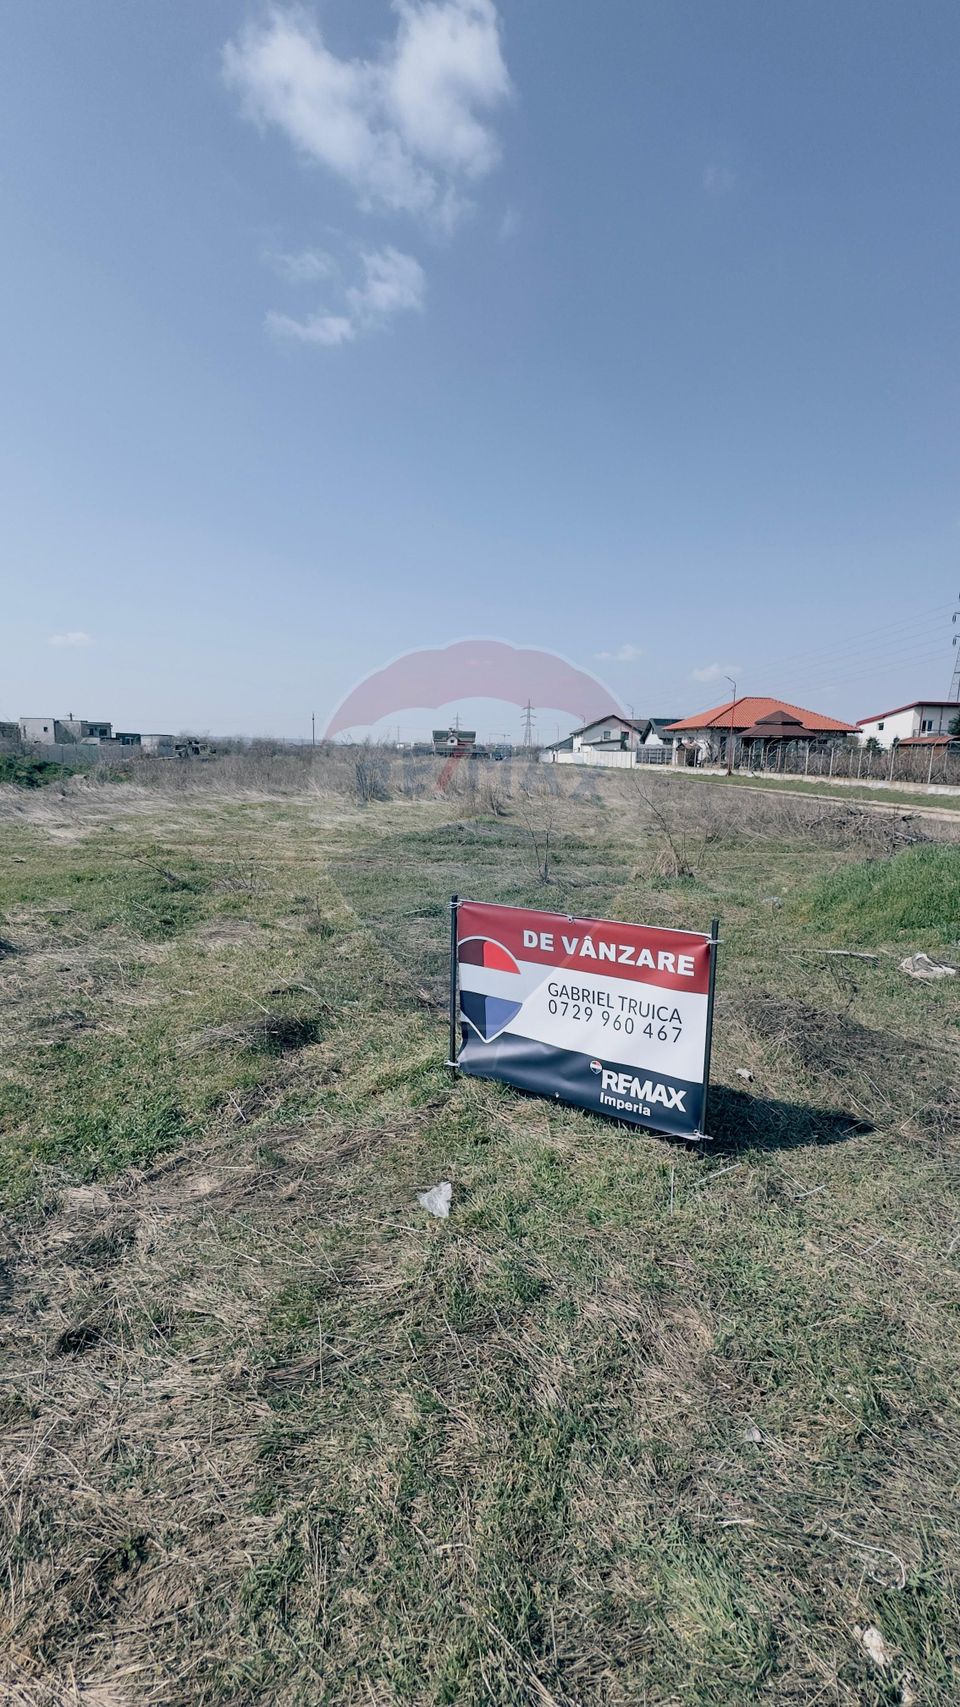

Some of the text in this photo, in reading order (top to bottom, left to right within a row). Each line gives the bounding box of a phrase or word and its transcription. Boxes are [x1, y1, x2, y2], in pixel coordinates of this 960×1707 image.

[523, 930, 695, 977] DE VÂNZARE
[547, 982, 682, 1025] GABRIEL TRUICA
[548, 1000, 683, 1043] 0729 960 467
[599, 1092, 652, 1117] Imperia
